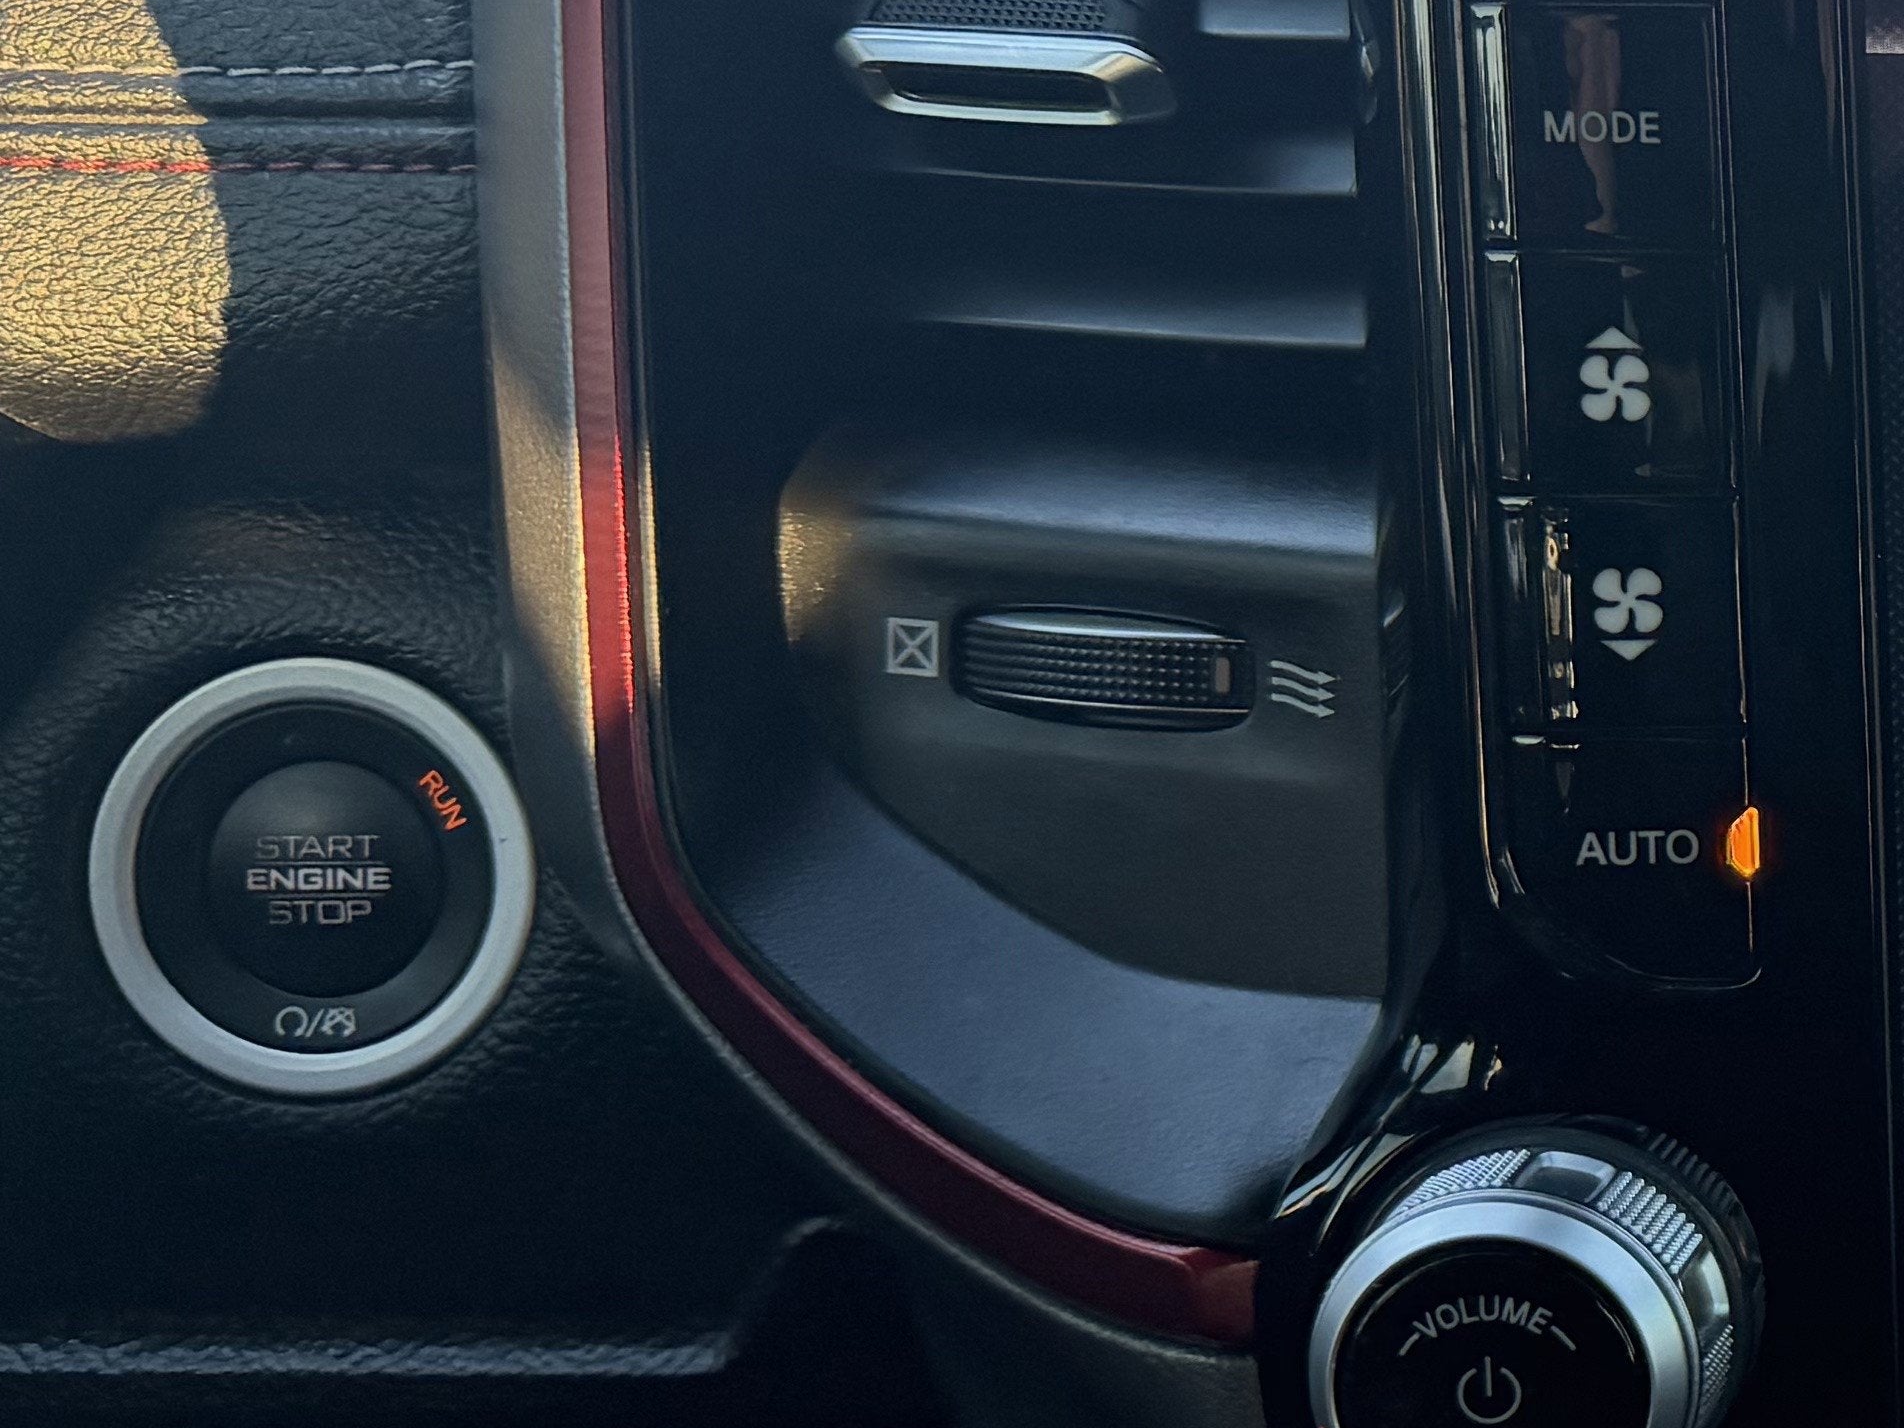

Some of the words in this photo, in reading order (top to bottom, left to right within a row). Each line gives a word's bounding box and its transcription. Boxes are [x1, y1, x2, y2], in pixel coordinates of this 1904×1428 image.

[1543, 111, 1661, 146] MODE
[418, 770, 466, 831] RUN
[257, 834, 378, 858] START
[1576, 829, 1699, 866] AUTO
[247, 867, 391, 891] ENGINE
[270, 899, 372, 925] STOP
[1413, 1295, 1553, 1341] VOLUME
